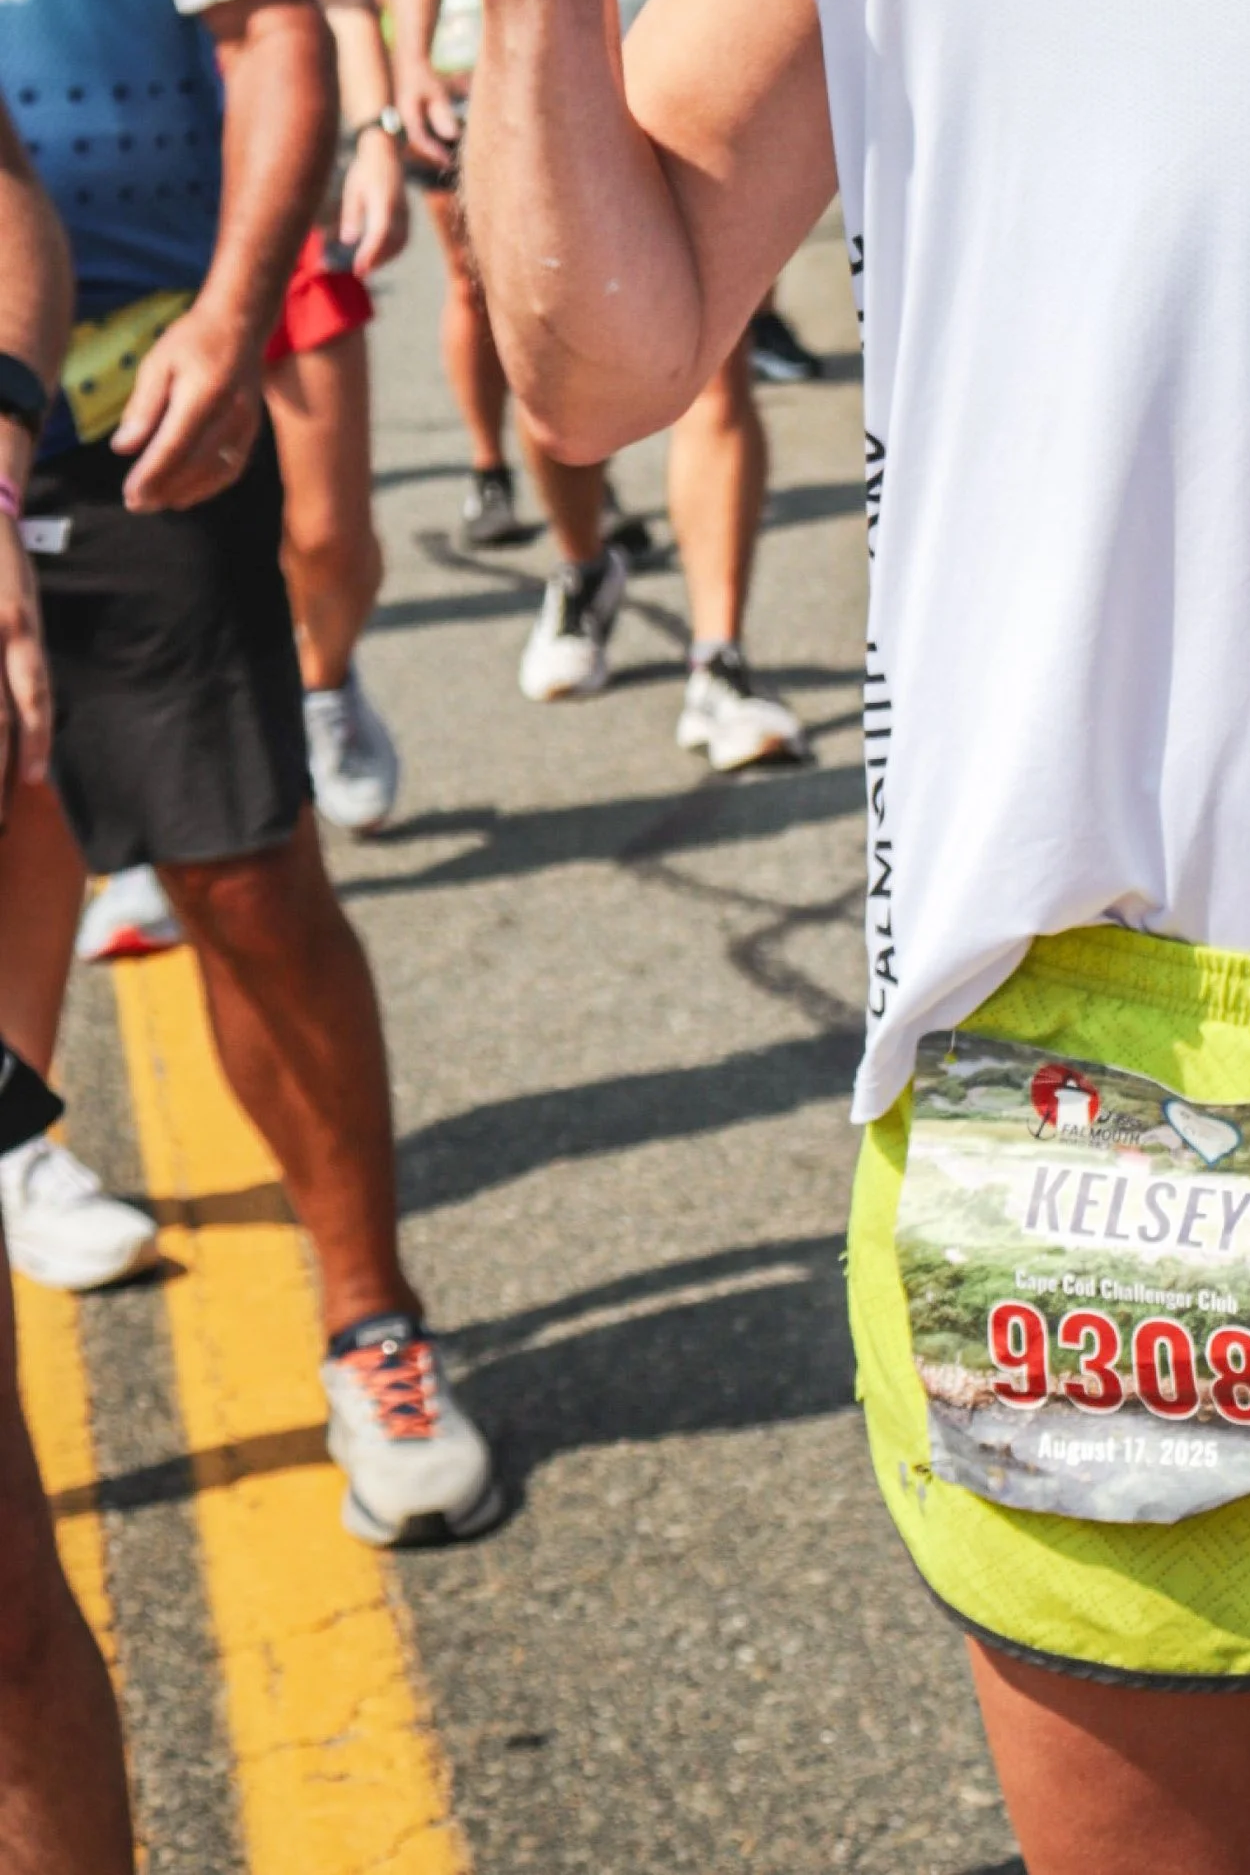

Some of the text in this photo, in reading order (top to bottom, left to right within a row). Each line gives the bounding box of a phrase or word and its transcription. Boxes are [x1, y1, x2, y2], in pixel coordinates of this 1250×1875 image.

[1060, 1123, 1141, 1146] FALMOUTH
[1015, 1270, 1239, 1315] Cape Cod Challenger Club
[1037, 1432, 1116, 1467] August
[1159, 1438, 1218, 1468] 2025
